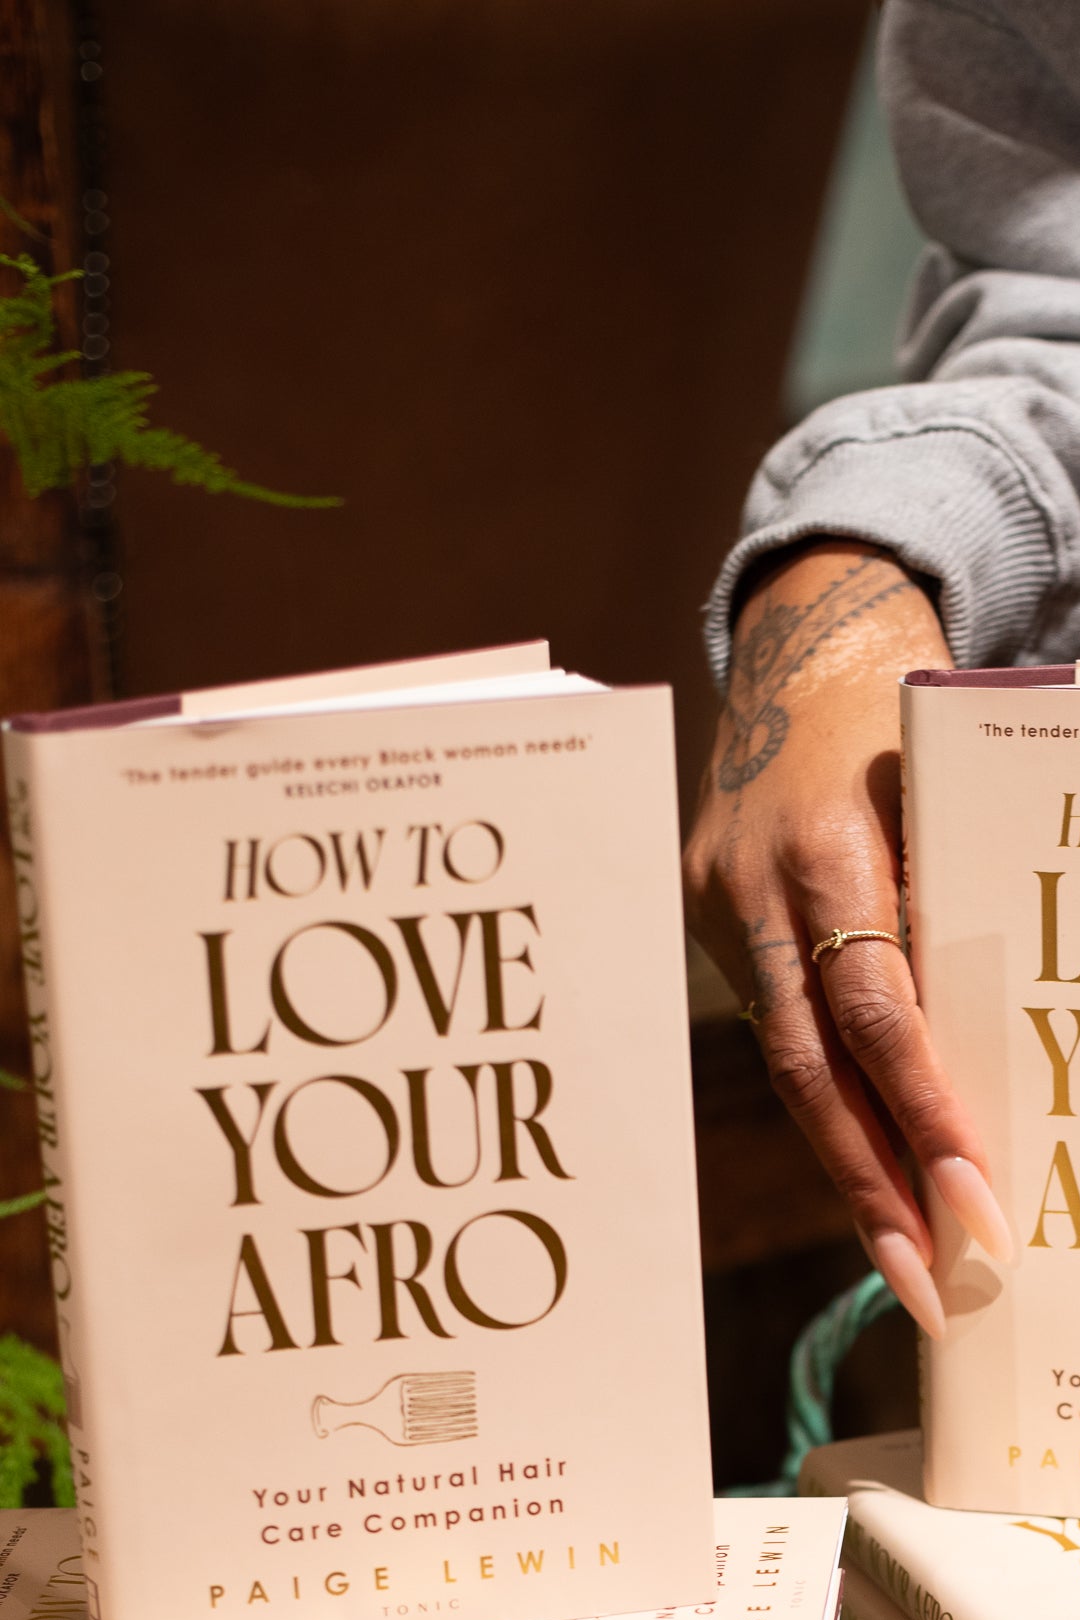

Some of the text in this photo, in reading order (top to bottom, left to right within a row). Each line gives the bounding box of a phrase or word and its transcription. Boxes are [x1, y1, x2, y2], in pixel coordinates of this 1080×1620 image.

[1020, 724, 1079, 739] tender
[169, 761, 238, 782] tender
[247, 757, 301, 778] guide
[313, 752, 370, 775] every
[379, 747, 436, 766] Black
[443, 744, 518, 762] woman
[285, 773, 444, 799] KELECHI OKAFOR
[222, 818, 507, 902] HOW TO
[195, 904, 546, 1058] LOVE
[194, 1057, 577, 1208] YOUR
[215, 1209, 570, 1357] AFRO
[252, 1458, 568, 1509] Your Natural Hair
[260, 1496, 565, 1545] Care Companion
[209, 1541, 620, 1608] PAIGE LEWIN
[753, 1526, 790, 1587] LEWIN
[381, 1598, 461, 1617] TONIC
